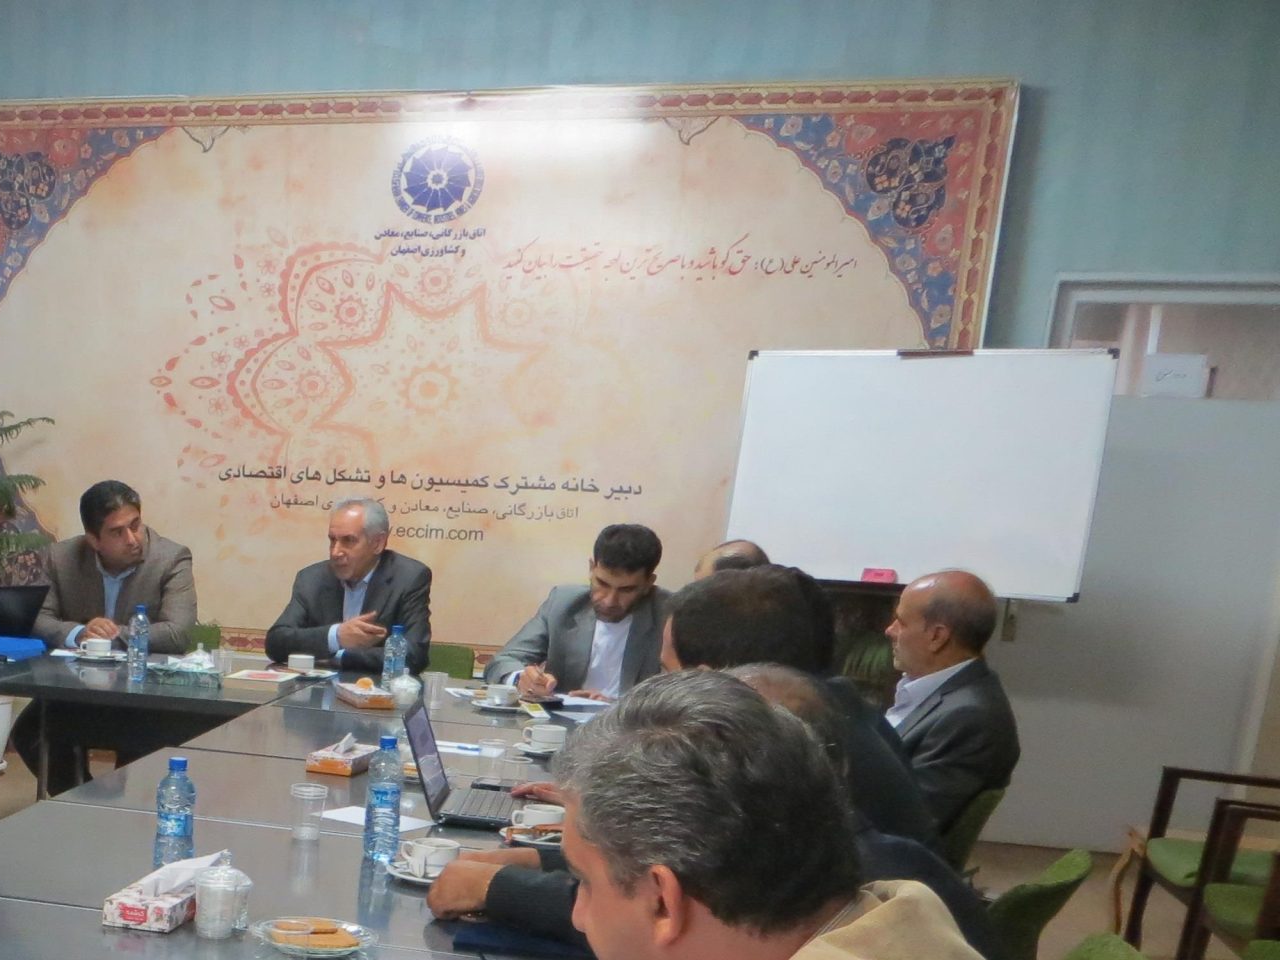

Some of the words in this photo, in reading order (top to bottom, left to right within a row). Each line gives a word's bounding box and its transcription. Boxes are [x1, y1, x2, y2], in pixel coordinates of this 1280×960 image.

[218, 463, 287, 482] اقتصادی
[289, 465, 322, 484] های
[325, 468, 371, 486] تشکل
[390, 469, 407, 486] ها
[374, 474, 387, 489] و
[410, 472, 490, 494] کمیسیون
[493, 474, 557, 496] مشترک
[270, 492, 319, 509] اصفهان
[399, 499, 440, 516] معادن
[387, 504, 398, 515] و
[555, 506, 580, 521] اتاق
